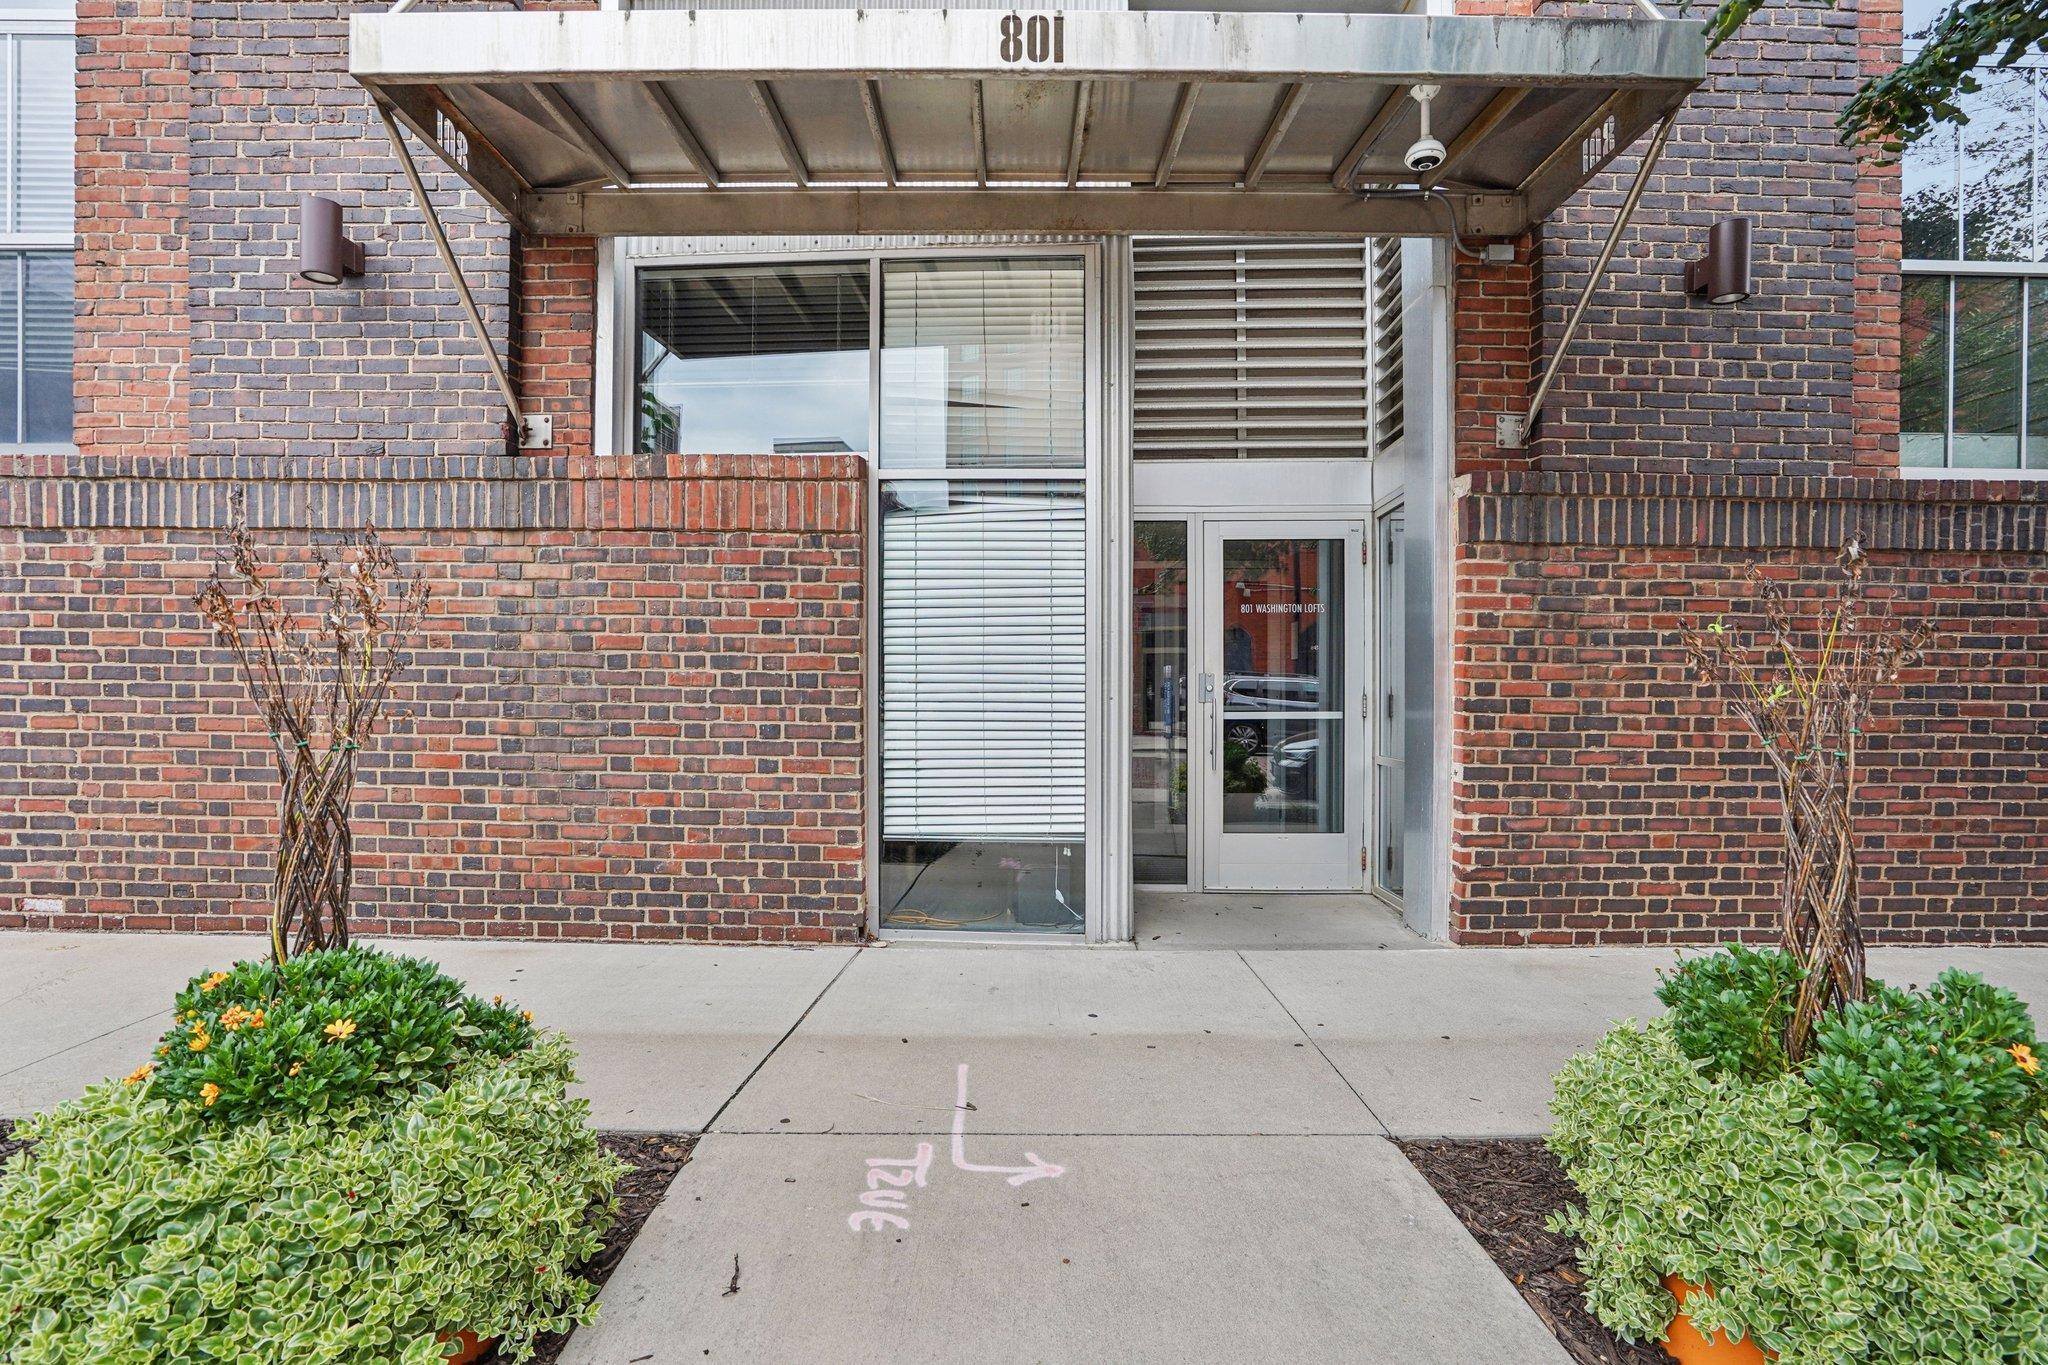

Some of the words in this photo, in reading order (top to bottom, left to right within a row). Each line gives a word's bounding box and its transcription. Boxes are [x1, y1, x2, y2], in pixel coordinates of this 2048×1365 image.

[1000, 14, 1064, 63] 801
[1240, 603, 1253, 614] 801
[1255, 603, 1303, 614] WASHINGTON
[1304, 603, 1326, 613] LOFTS
